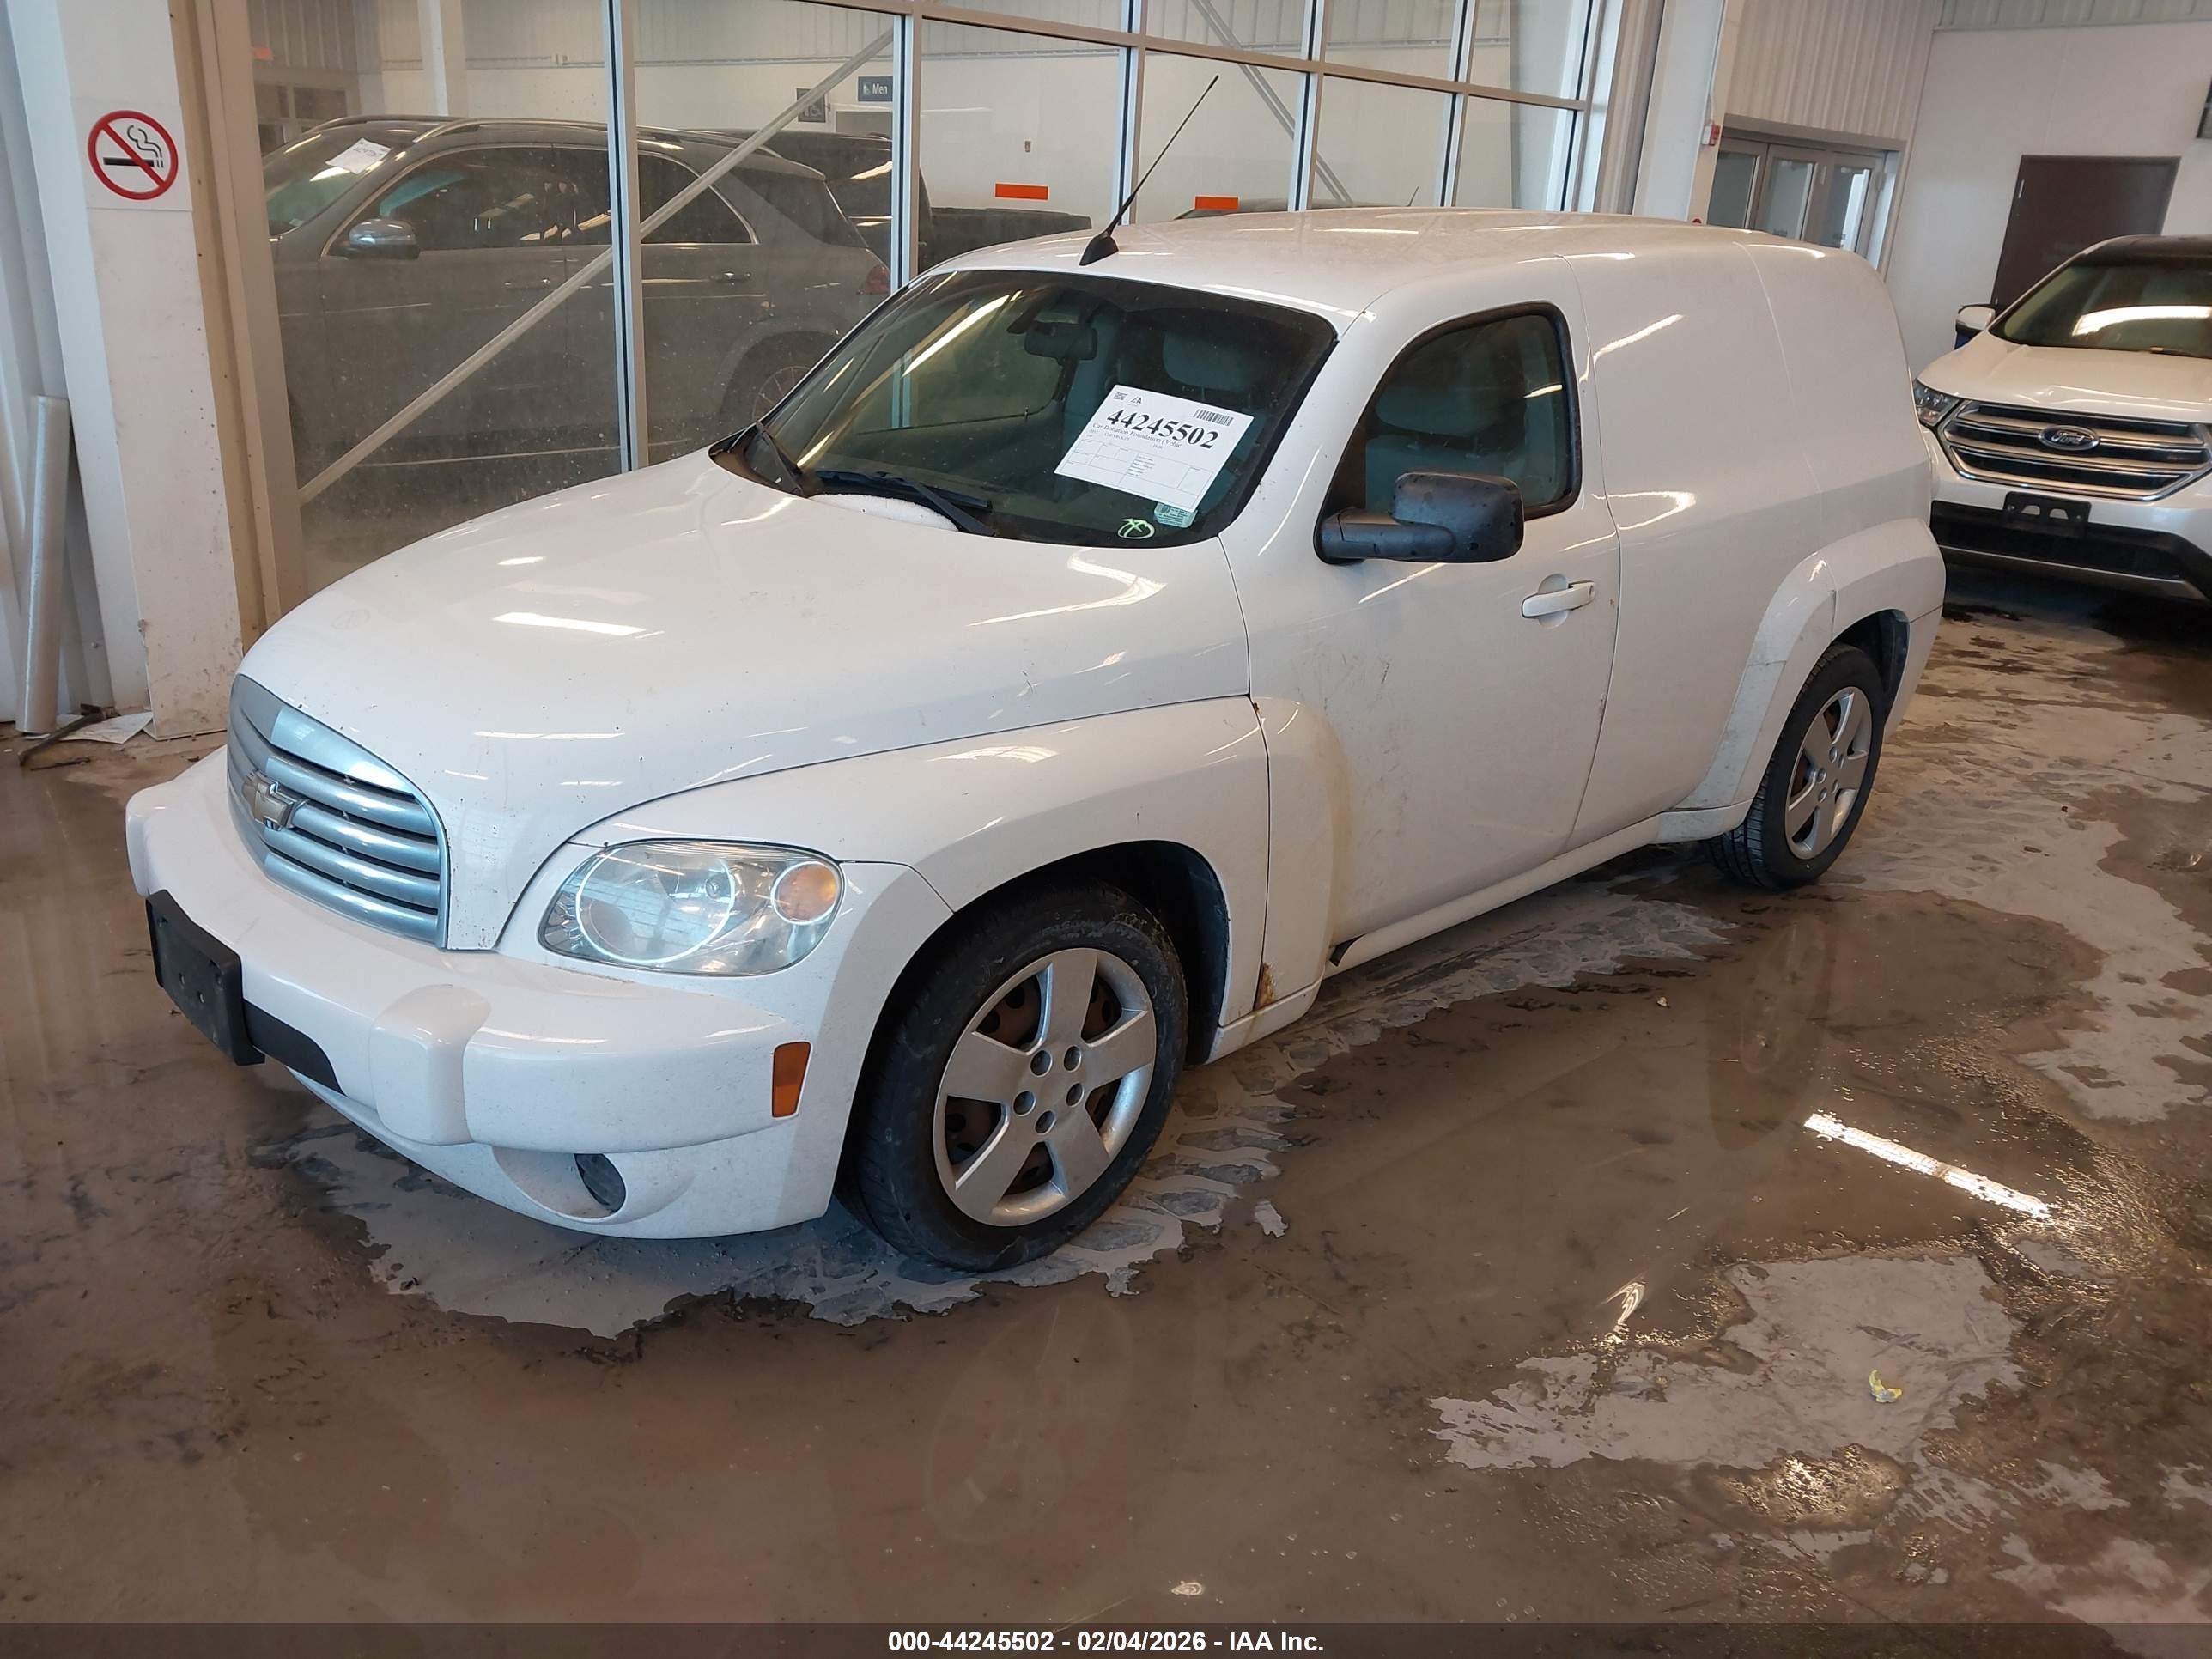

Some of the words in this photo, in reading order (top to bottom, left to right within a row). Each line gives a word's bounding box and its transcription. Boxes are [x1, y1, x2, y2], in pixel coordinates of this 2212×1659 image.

[872, 82, 888, 95] Men
[1103, 424, 1129, 435] Donation
[1129, 430, 1162, 442] Foundation
[1107, 409, 1219, 449] 44245502
[2051, 430, 2085, 445] Ford
